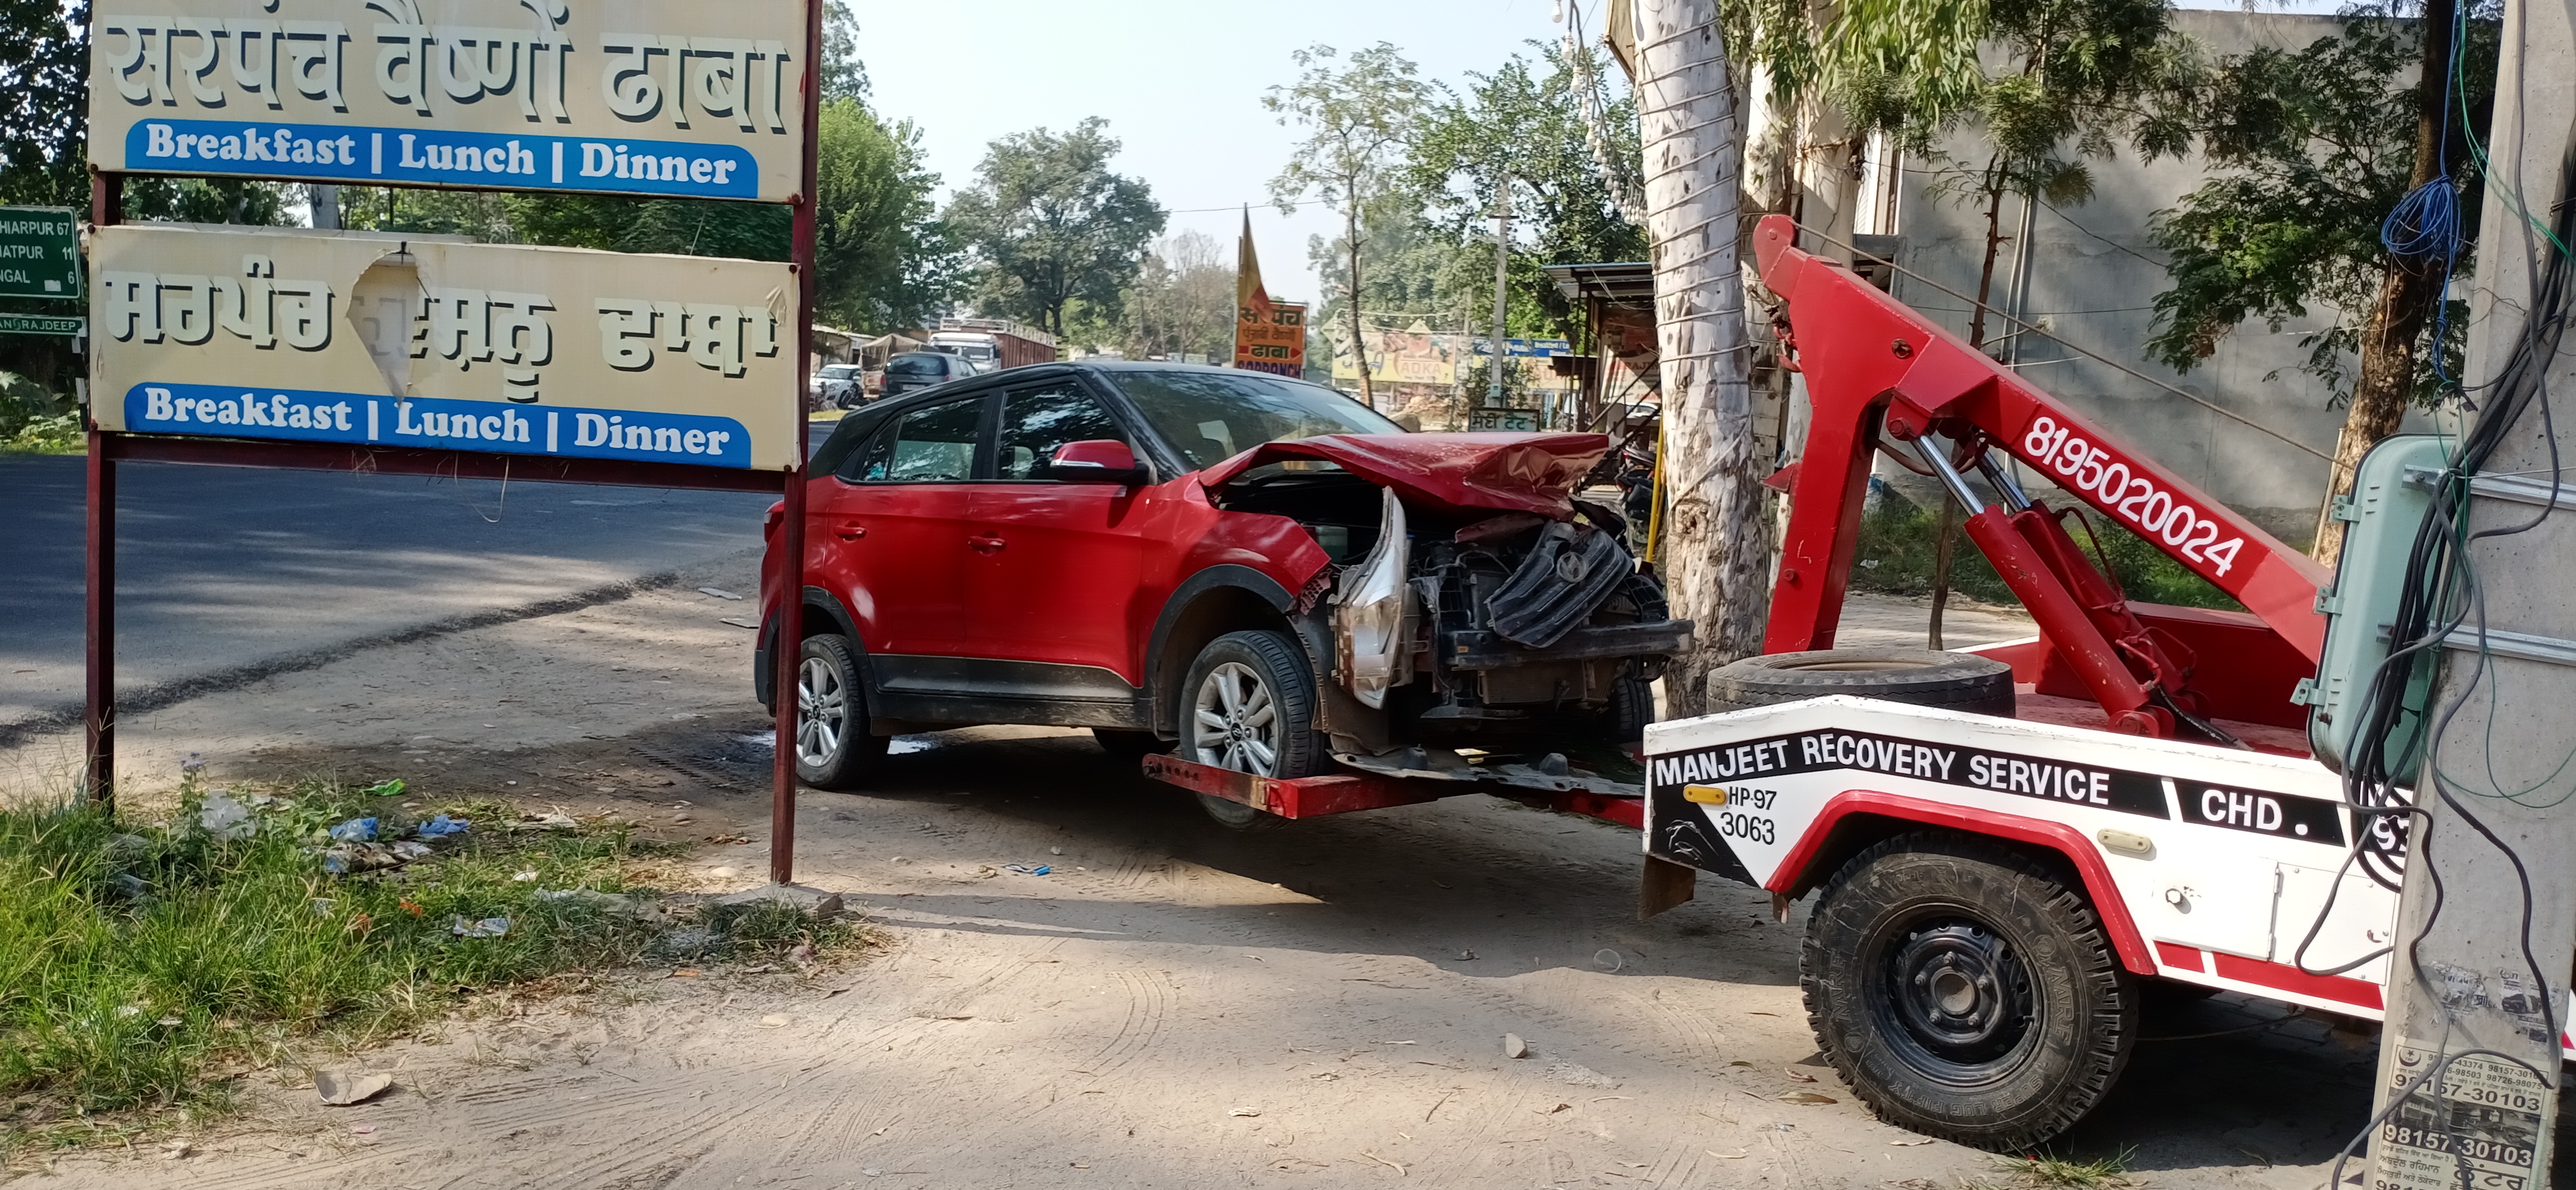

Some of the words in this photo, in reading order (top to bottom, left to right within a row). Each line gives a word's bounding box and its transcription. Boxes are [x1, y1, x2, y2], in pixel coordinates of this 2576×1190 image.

[103, 0, 352, 114] सरपंच
[599, 32, 792, 135] ढाबा
[146, 123, 356, 166] Breakfast
[399, 133, 536, 174] Lunch
[579, 143, 737, 185] Dinner
[57, 223, 69, 235] 67
[0, 245, 44, 259] ATPUR
[62, 247, 73, 261] 11
[68, 271, 75, 284] 6
[22, 319, 76, 331] RAJDEEP
[102, 254, 337, 352] ਸਰਪੰਚ
[594, 296, 781, 379] ਢਾਬਾ
[1240, 305, 1301, 325] सपंच
[145, 388, 352, 431] Breakfast
[395, 401, 531, 442] Lunch
[574, 413, 730, 456] Dinner
[2025, 417, 2244, 577] 8195020024
[1655, 739, 1789, 787] MANJEET
[1801, 733, 1956, 781] RECOVERY
[1968, 755, 2110, 805] SERVICE
[1720, 812, 1775, 845] 3063
[2048, 966, 2075, 1046] MRF
[1991, 1075, 2044, 1113] SUPER
[2487, 1074, 2542, 1089] 98726-98075
[1950, 1103, 1985, 1117] LUG
[2385, 1124, 2531, 1166] 98157-30103
